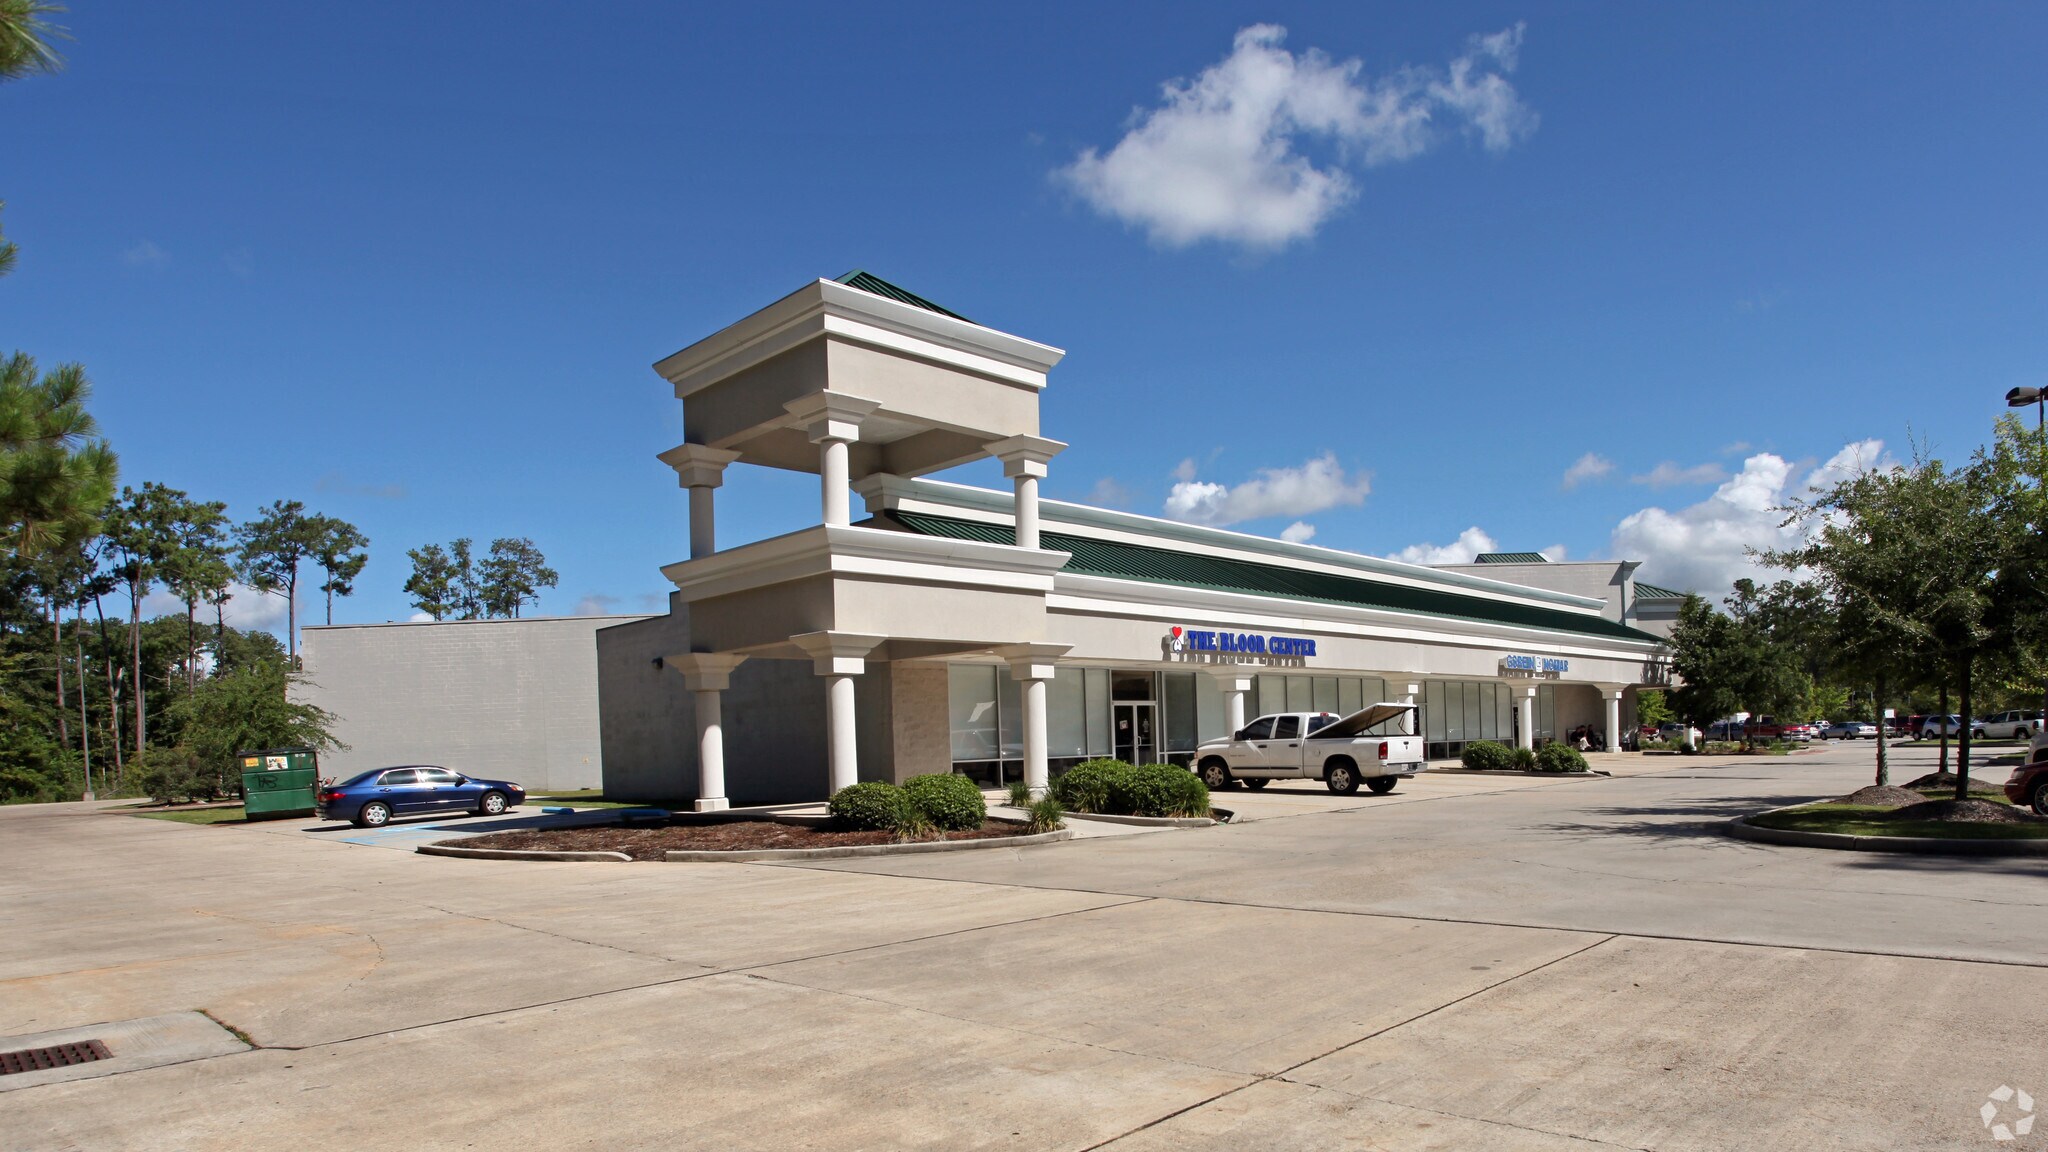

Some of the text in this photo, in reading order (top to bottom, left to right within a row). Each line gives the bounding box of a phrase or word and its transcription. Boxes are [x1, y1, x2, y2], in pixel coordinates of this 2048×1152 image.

[1187, 630, 1316, 656] THE BLOOD CENTER
